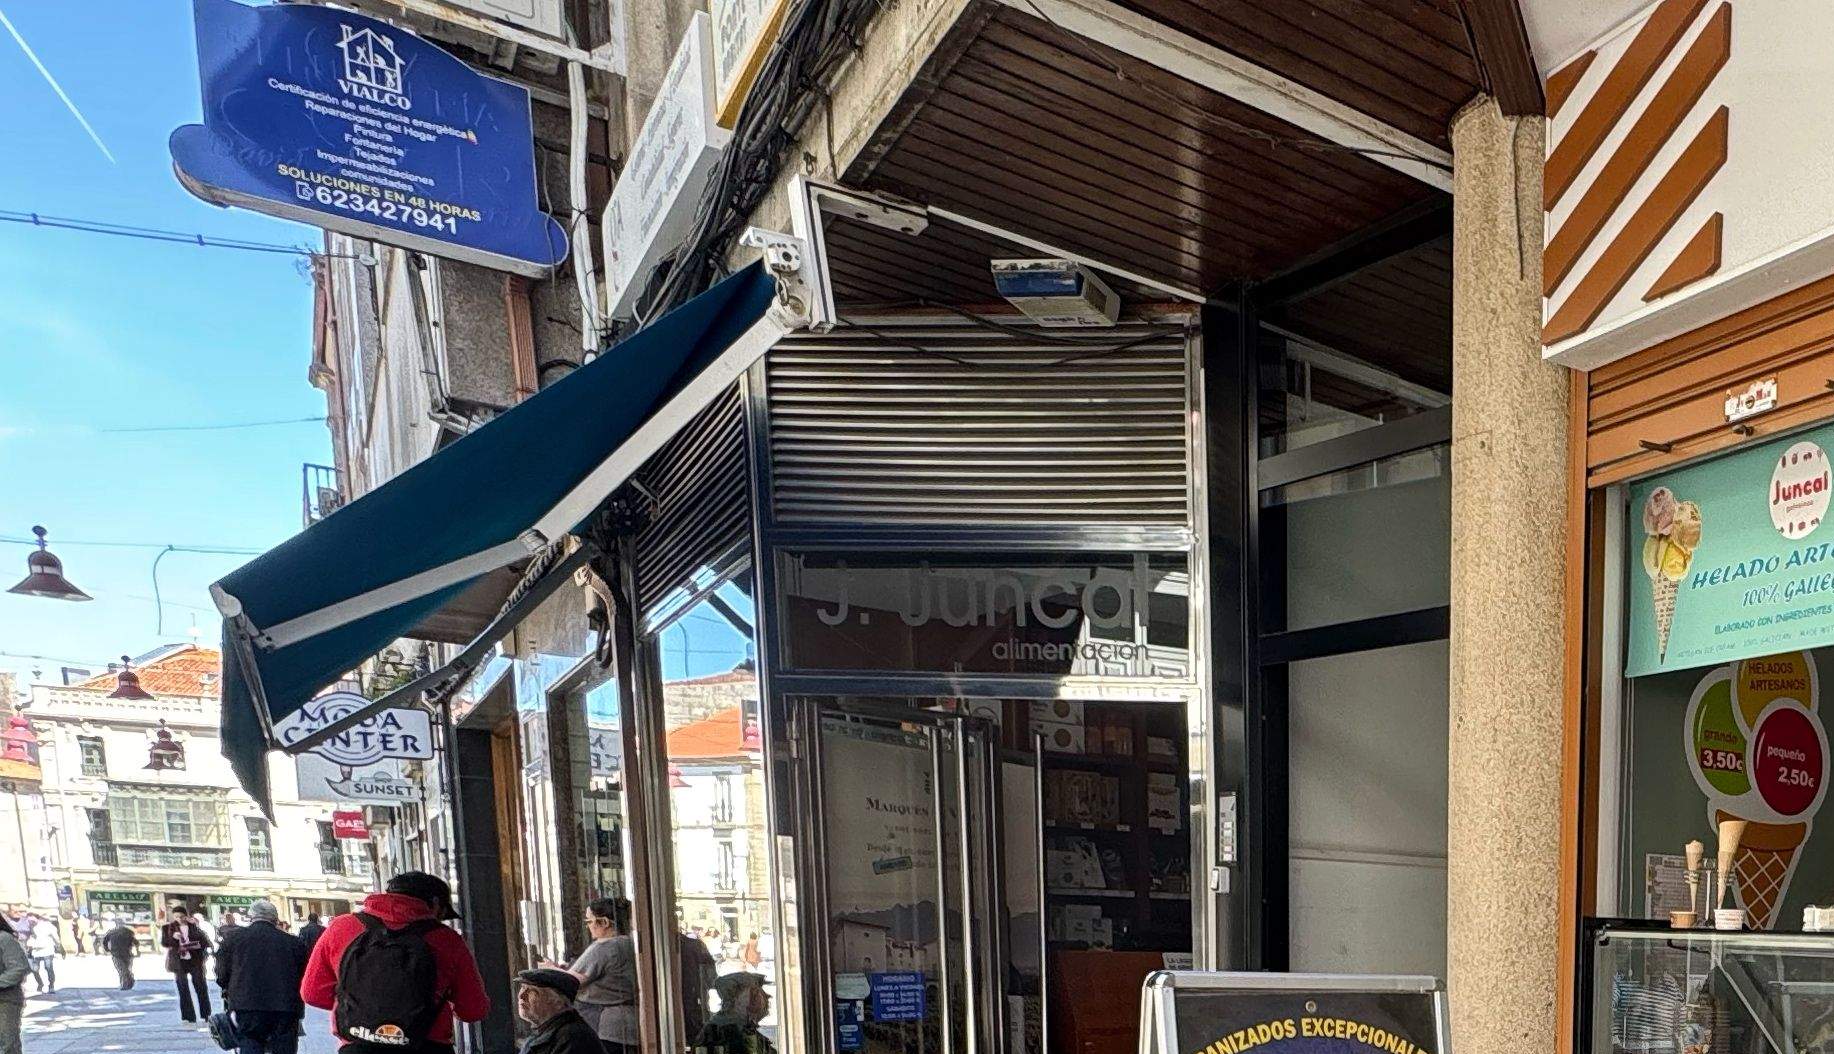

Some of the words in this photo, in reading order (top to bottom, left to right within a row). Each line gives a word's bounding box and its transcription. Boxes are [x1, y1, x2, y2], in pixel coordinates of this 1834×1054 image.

[337, 79, 412, 110] VIALCO
[342, 96, 356, 110] de
[305, 100, 382, 128] Reparaciones
[402, 125, 437, 143] Hogar
[353, 125, 393, 142] Pintura
[277, 164, 381, 197] SOLUCIONES
[384, 189, 406, 203] EN
[408, 195, 427, 209] 48
[429, 200, 482, 221] HORAS
[316, 186, 457, 235] 623427941
[1773, 471, 1828, 505] Juncal
[1692, 556, 1780, 589] HELADO
[1742, 583, 1782, 607] 100%
[1714, 619, 1755, 635] ELABORADO
[1757, 615, 1773, 627] CON
[1775, 606, 1833, 623] INGREDIENTES
[1748, 662, 1793, 674] HELADOS
[1749, 679, 1806, 691] ARTESANOS
[284, 727, 421, 753] CNTER
[354, 783, 413, 797] SUNSET
